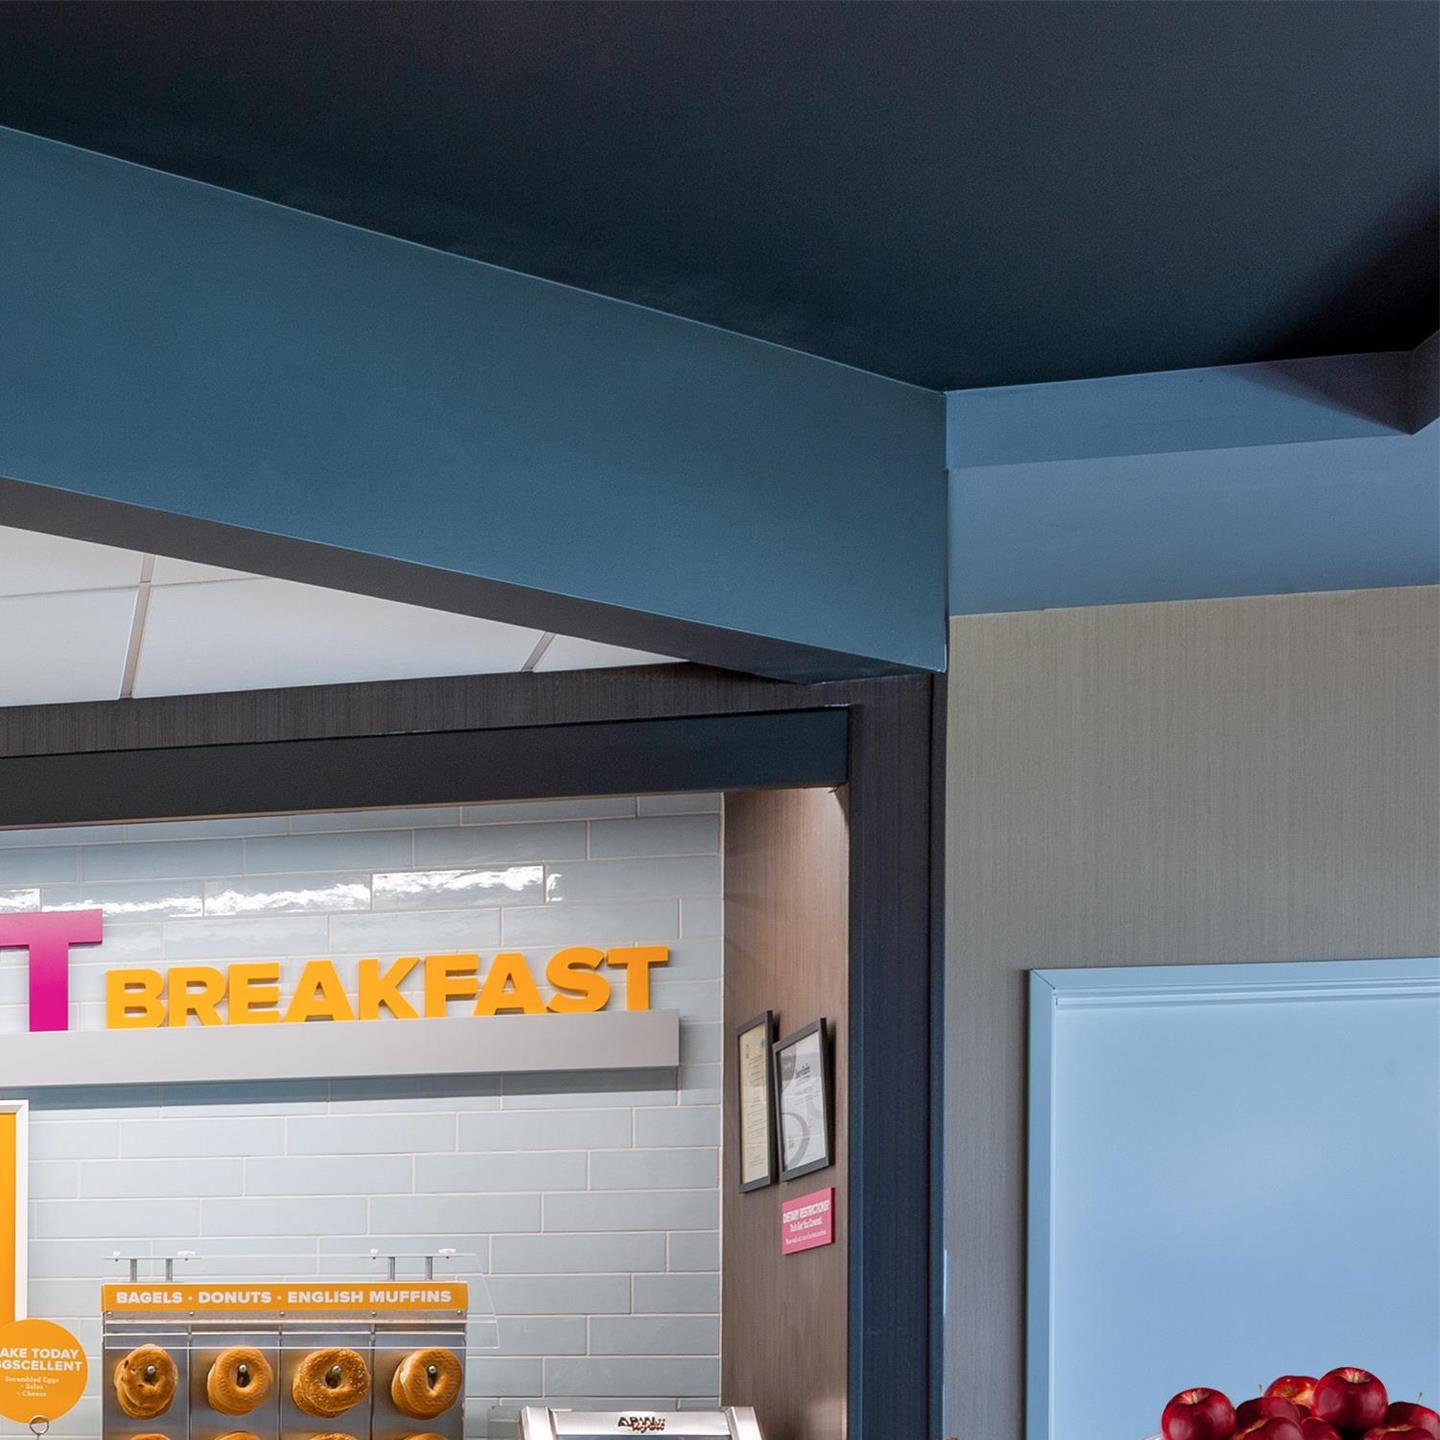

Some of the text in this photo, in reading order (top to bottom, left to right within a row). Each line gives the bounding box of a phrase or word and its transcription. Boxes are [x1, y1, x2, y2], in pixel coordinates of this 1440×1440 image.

[105, 946, 669, 1029] BREAKFAST
[116, 1288, 452, 1304] BAGELS DONUTS ENGLISH MUFFINS
[31, 1348, 79, 1359] TODAY
